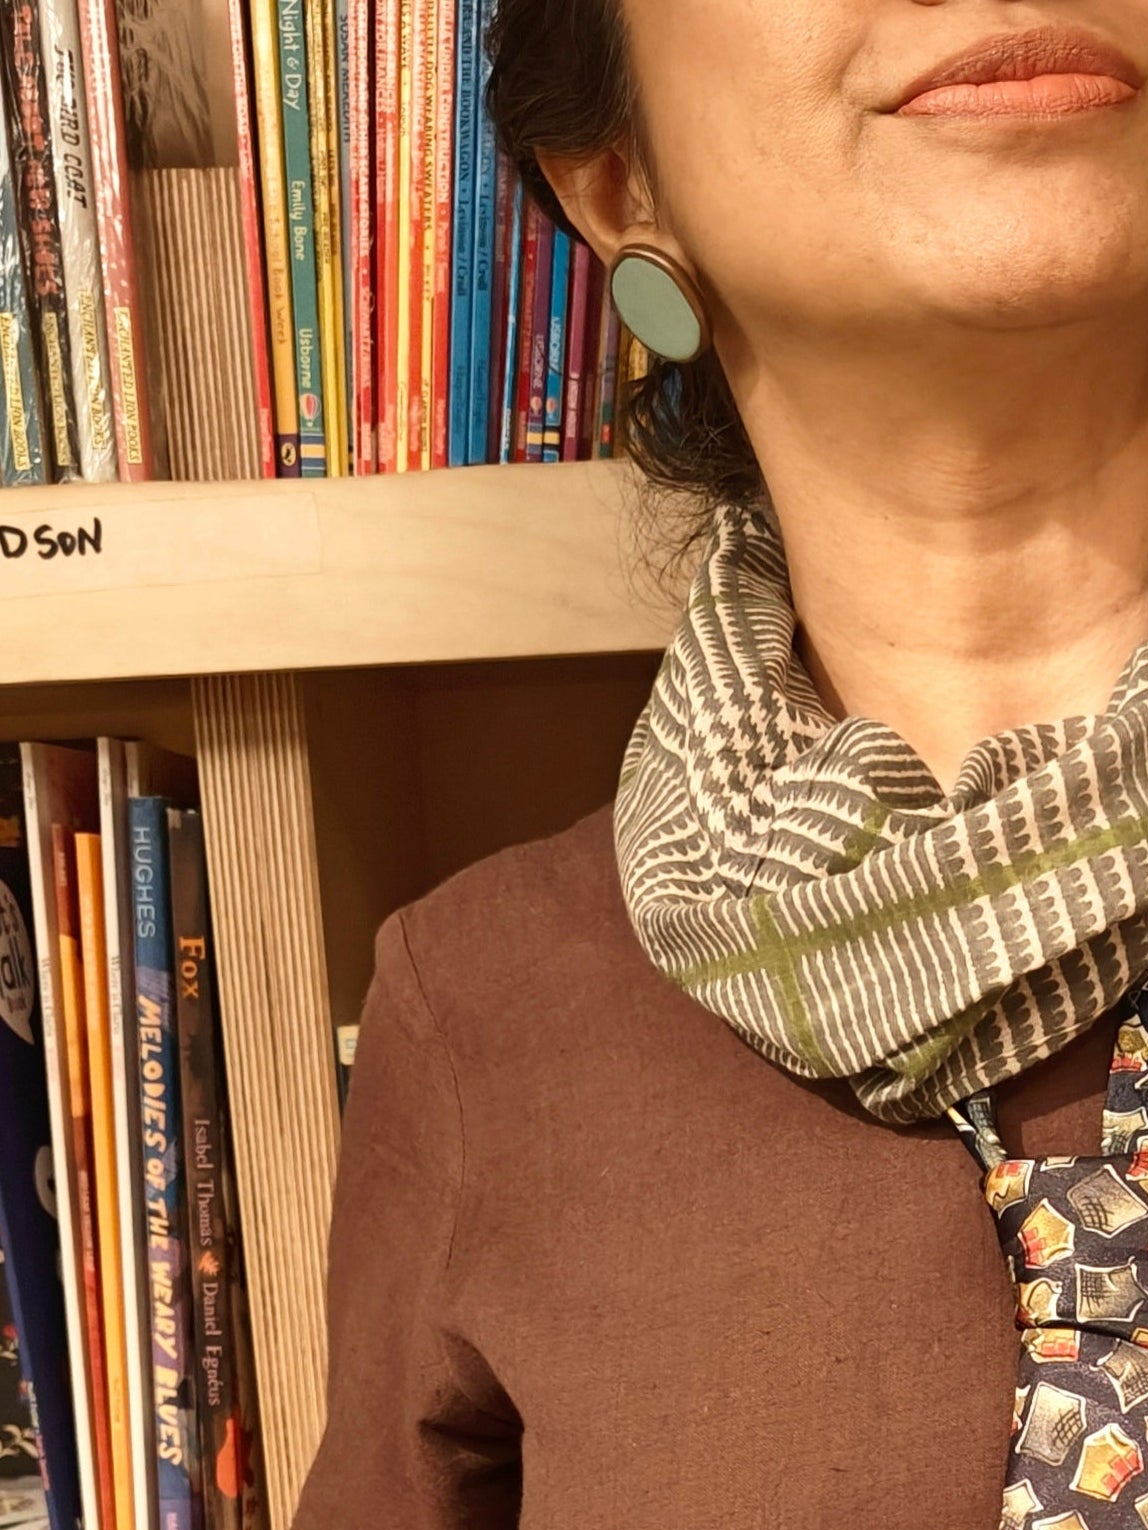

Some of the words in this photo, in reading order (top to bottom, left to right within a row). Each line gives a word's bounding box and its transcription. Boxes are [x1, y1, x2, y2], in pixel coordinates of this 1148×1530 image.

[279, 0, 300, 51] Night
[283, 74, 302, 110] Day
[376, 54, 385, 112] FRANCES
[425, 61, 434, 90] DOG
[462, 59, 472, 86] THE
[424, 94, 434, 159] WEARING
[438, 94, 449, 203] CONSTRUCTION
[459, 89, 472, 181] BOOKWAGON
[290, 181, 306, 220] Emily
[423, 162, 433, 230] SWEATERS
[293, 226, 309, 261] Bone
[298, 328, 314, 389] Usborne
[124, 392, 134, 424] LION
[132, 826, 156, 939] HUGHES
[178, 936, 207, 999] Fox
[137, 995, 168, 1153] MELODIES
[193, 1118, 213, 1169] Isabel
[145, 1157, 165, 1190] OF
[147, 1197, 169, 1248] THE
[196, 1180, 214, 1247] Thomas
[151, 1261, 178, 1360] WEARY
[201, 1282, 221, 1336] Daniel
[201, 1344, 223, 1406] Egnéus
[155, 1364, 183, 1465] BLUES
